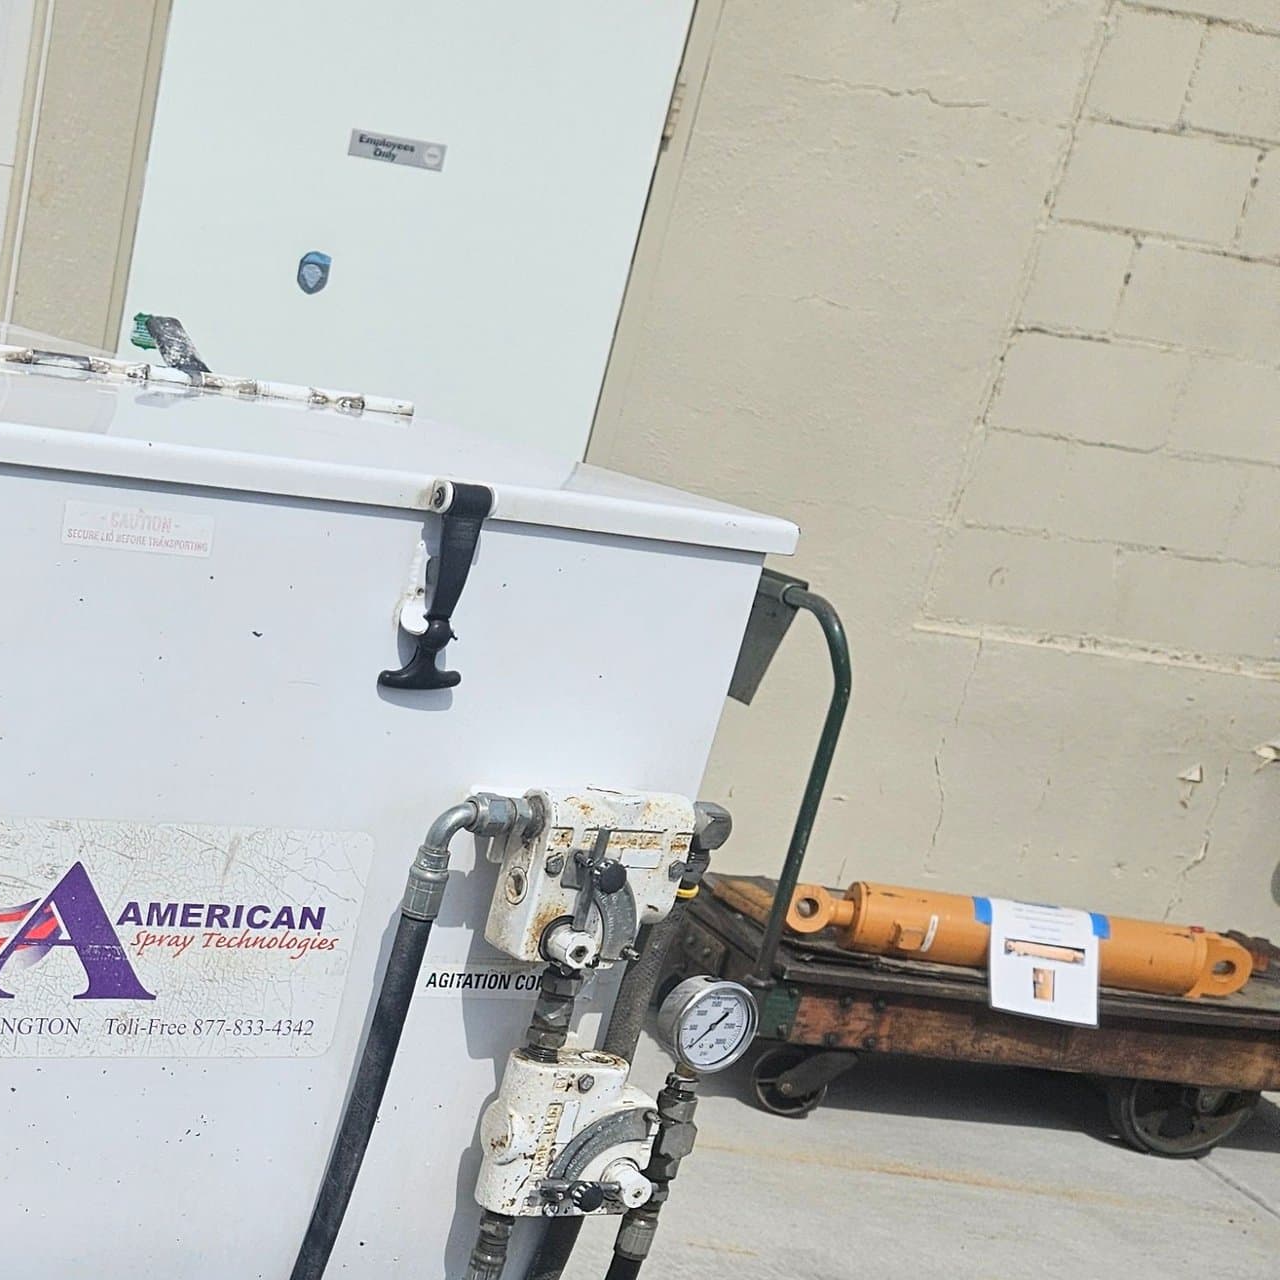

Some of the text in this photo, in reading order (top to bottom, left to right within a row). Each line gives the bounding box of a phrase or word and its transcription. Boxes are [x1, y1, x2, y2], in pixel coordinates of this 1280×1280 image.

[358, 134, 415, 153] Employees
[373, 148, 397, 162] Only
[116, 901, 328, 931] AMERICAN
[131, 930, 340, 960] Spray Technologies
[425, 972, 511, 990] AGITATION
[192, 1018, 315, 1036] 877-833-4342
